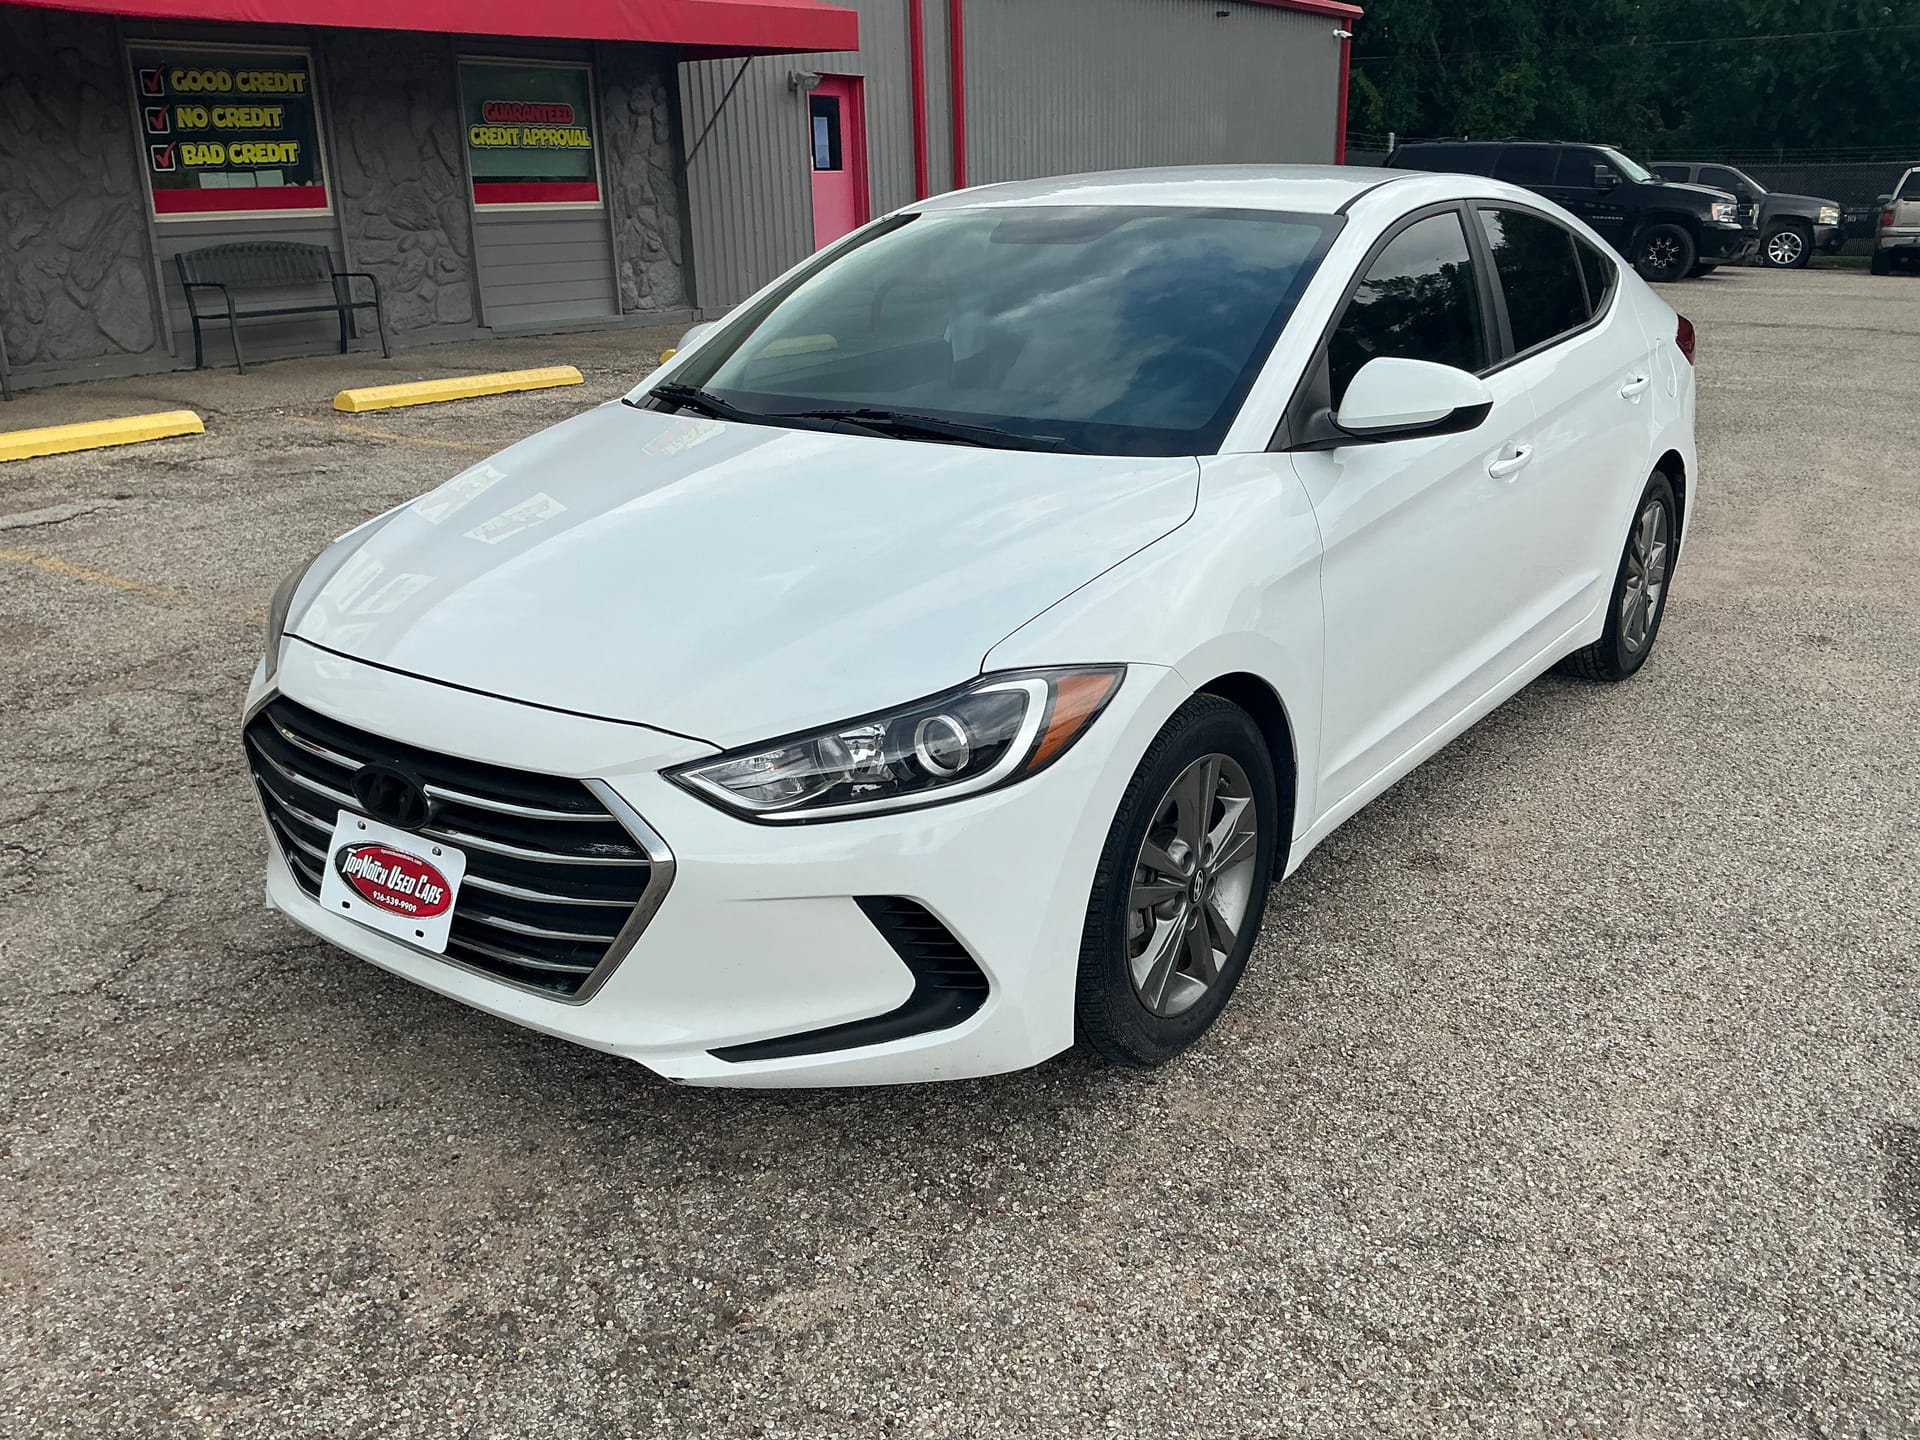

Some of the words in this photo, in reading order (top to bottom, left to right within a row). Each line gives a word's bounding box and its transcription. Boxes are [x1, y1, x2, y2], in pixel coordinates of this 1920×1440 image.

[171, 69, 232, 92] GOOD
[236, 71, 306, 93] CREDIT
[176, 105, 208, 128] NO
[212, 106, 282, 129] CREDIT
[484, 101, 573, 124] GUARANTEED
[471, 127, 520, 146] CREDIT
[522, 128, 590, 147] APPROVAL
[181, 143, 225, 166] BAD
[229, 142, 297, 166] CREDIT
[372, 891, 417, 912] 936-539-9909
